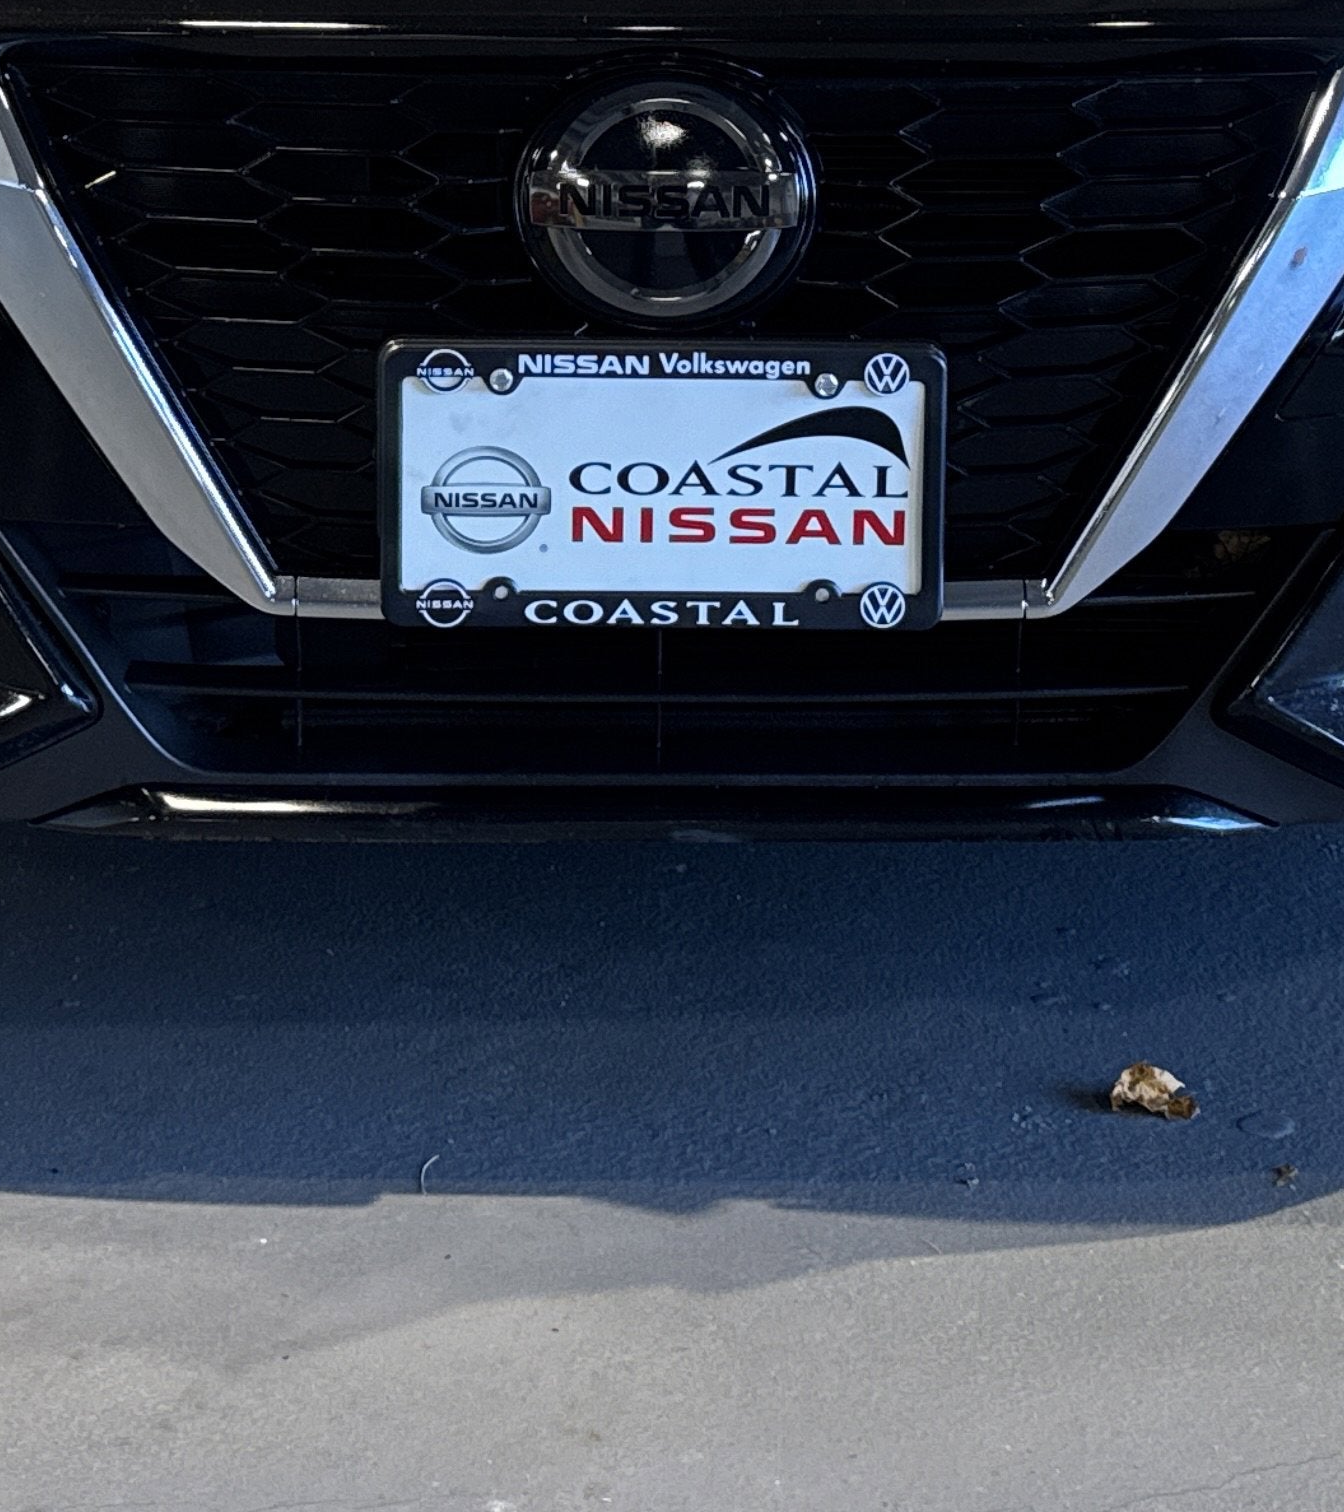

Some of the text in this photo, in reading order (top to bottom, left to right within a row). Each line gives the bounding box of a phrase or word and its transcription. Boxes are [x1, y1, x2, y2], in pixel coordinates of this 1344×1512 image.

[559, 184, 770, 218] NISSAN
[416, 367, 475, 377] NISSAN
[518, 352, 811, 378] NISSAN Volkswagen
[568, 461, 909, 499] COASTAL
[434, 491, 538, 510] NISSAN
[571, 506, 906, 546] NISSAN
[416, 599, 474, 610] NISSAN
[524, 598, 799, 627] COASTAL
